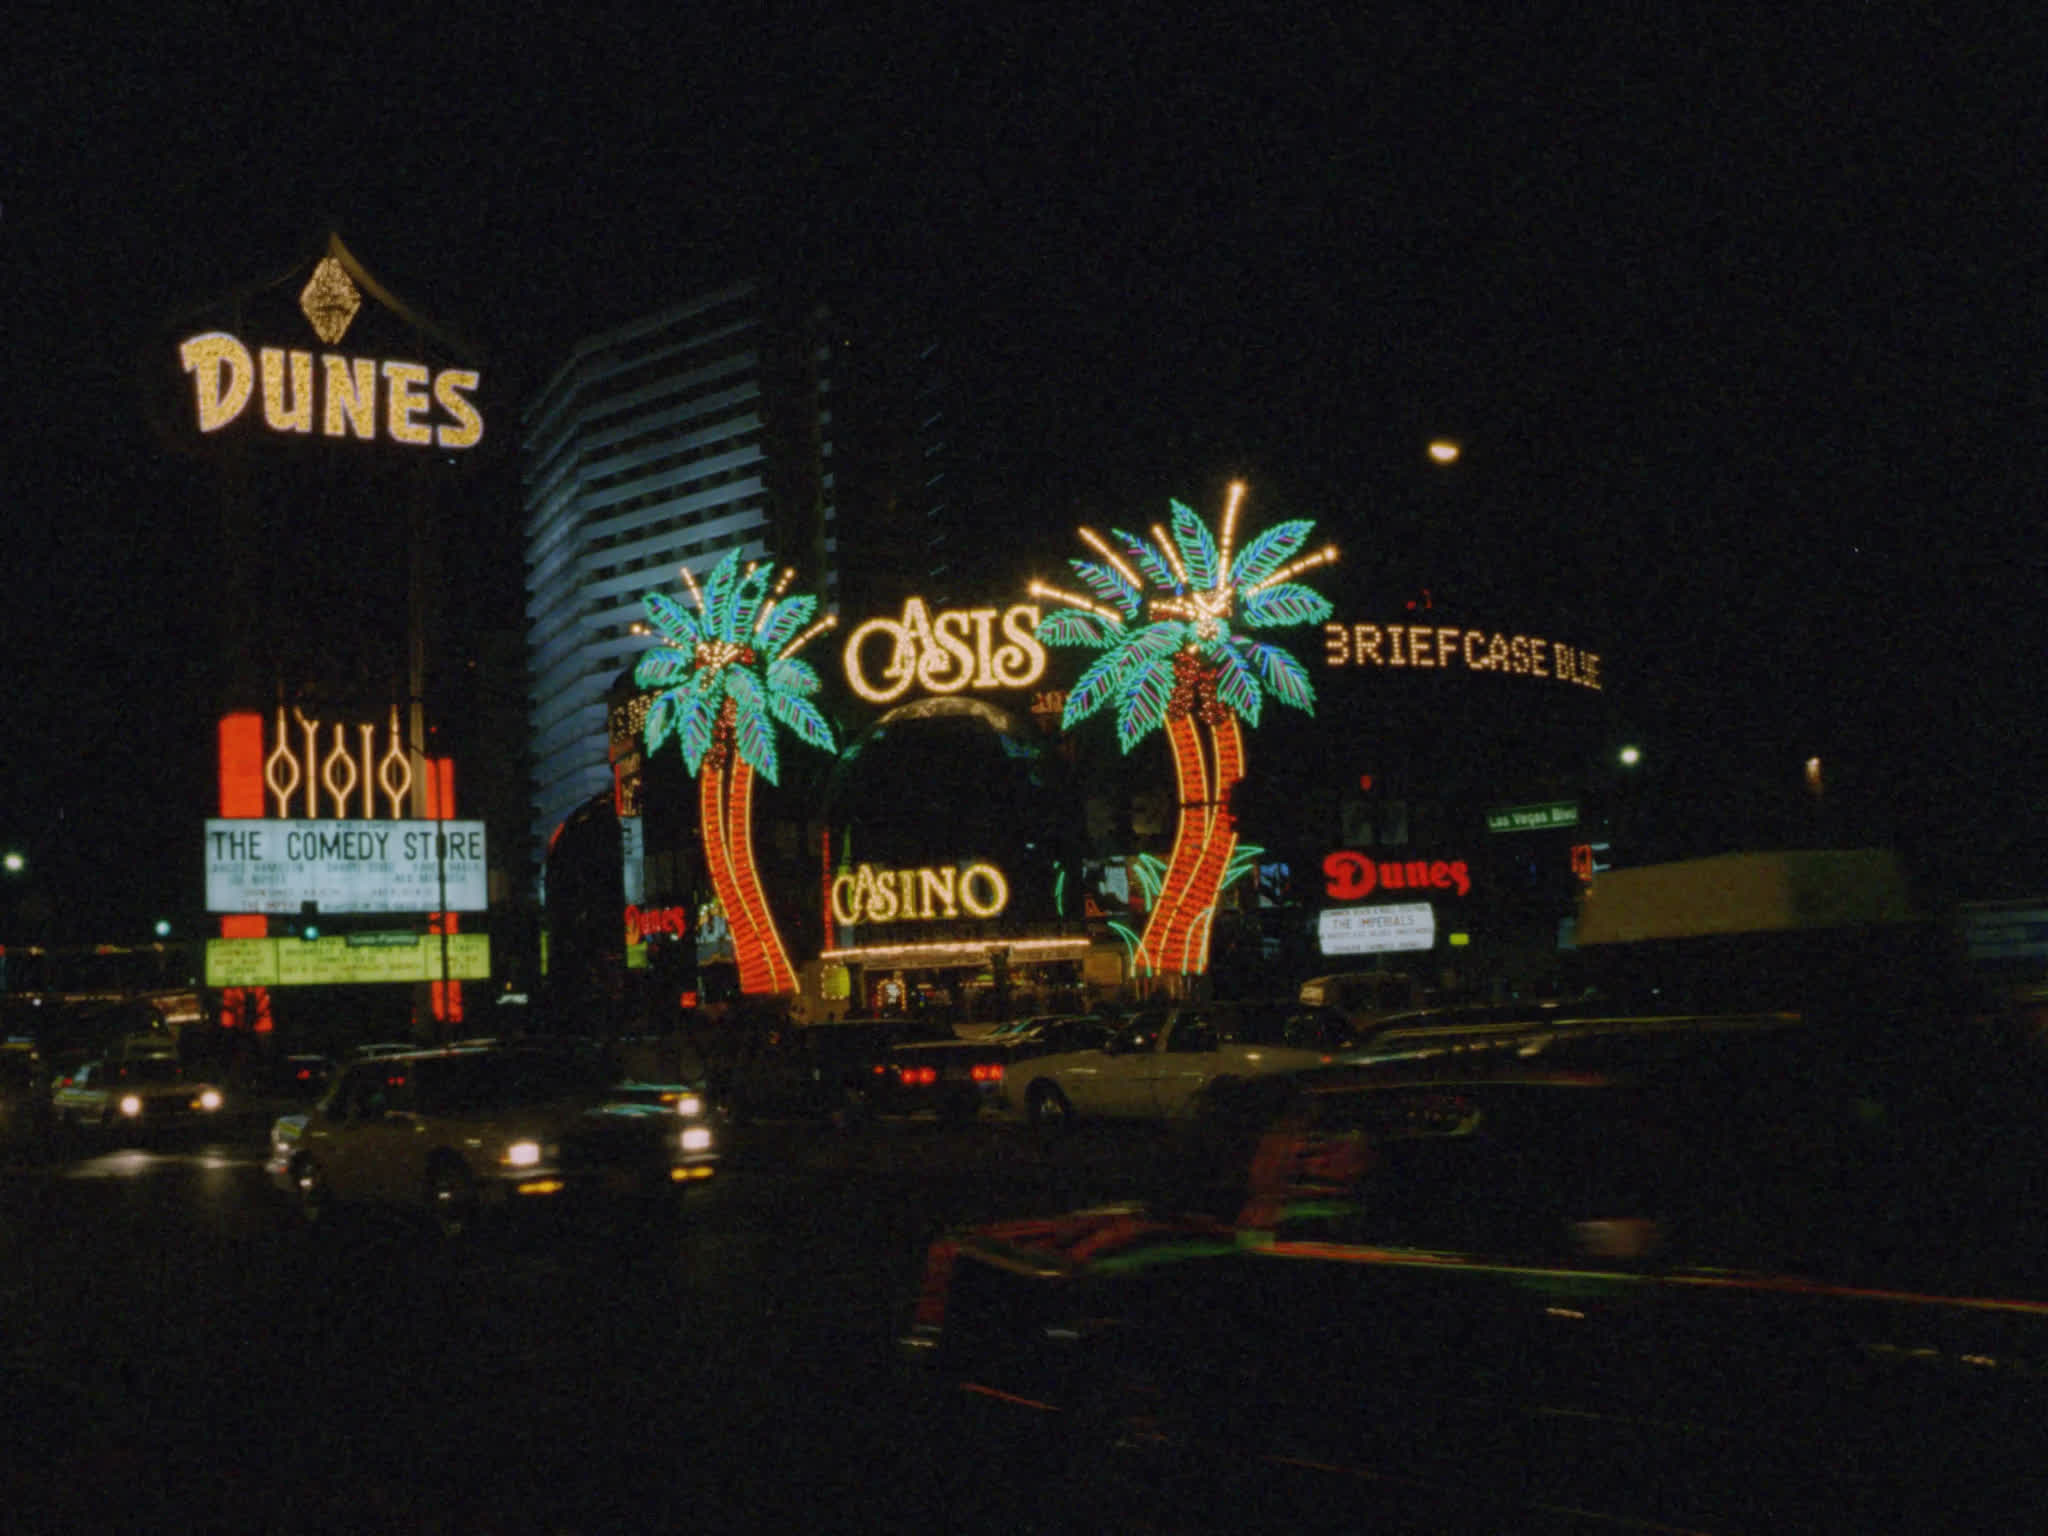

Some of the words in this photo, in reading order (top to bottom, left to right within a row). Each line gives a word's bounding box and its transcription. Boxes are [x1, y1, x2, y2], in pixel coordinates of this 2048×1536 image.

[180, 331, 484, 448] DUNES
[843, 596, 1046, 703] OASIS
[213, 831, 263, 861] THE
[287, 831, 390, 861] COMEDY
[1323, 851, 1472, 900] Dunes
[832, 863, 1009, 927] CASINO
